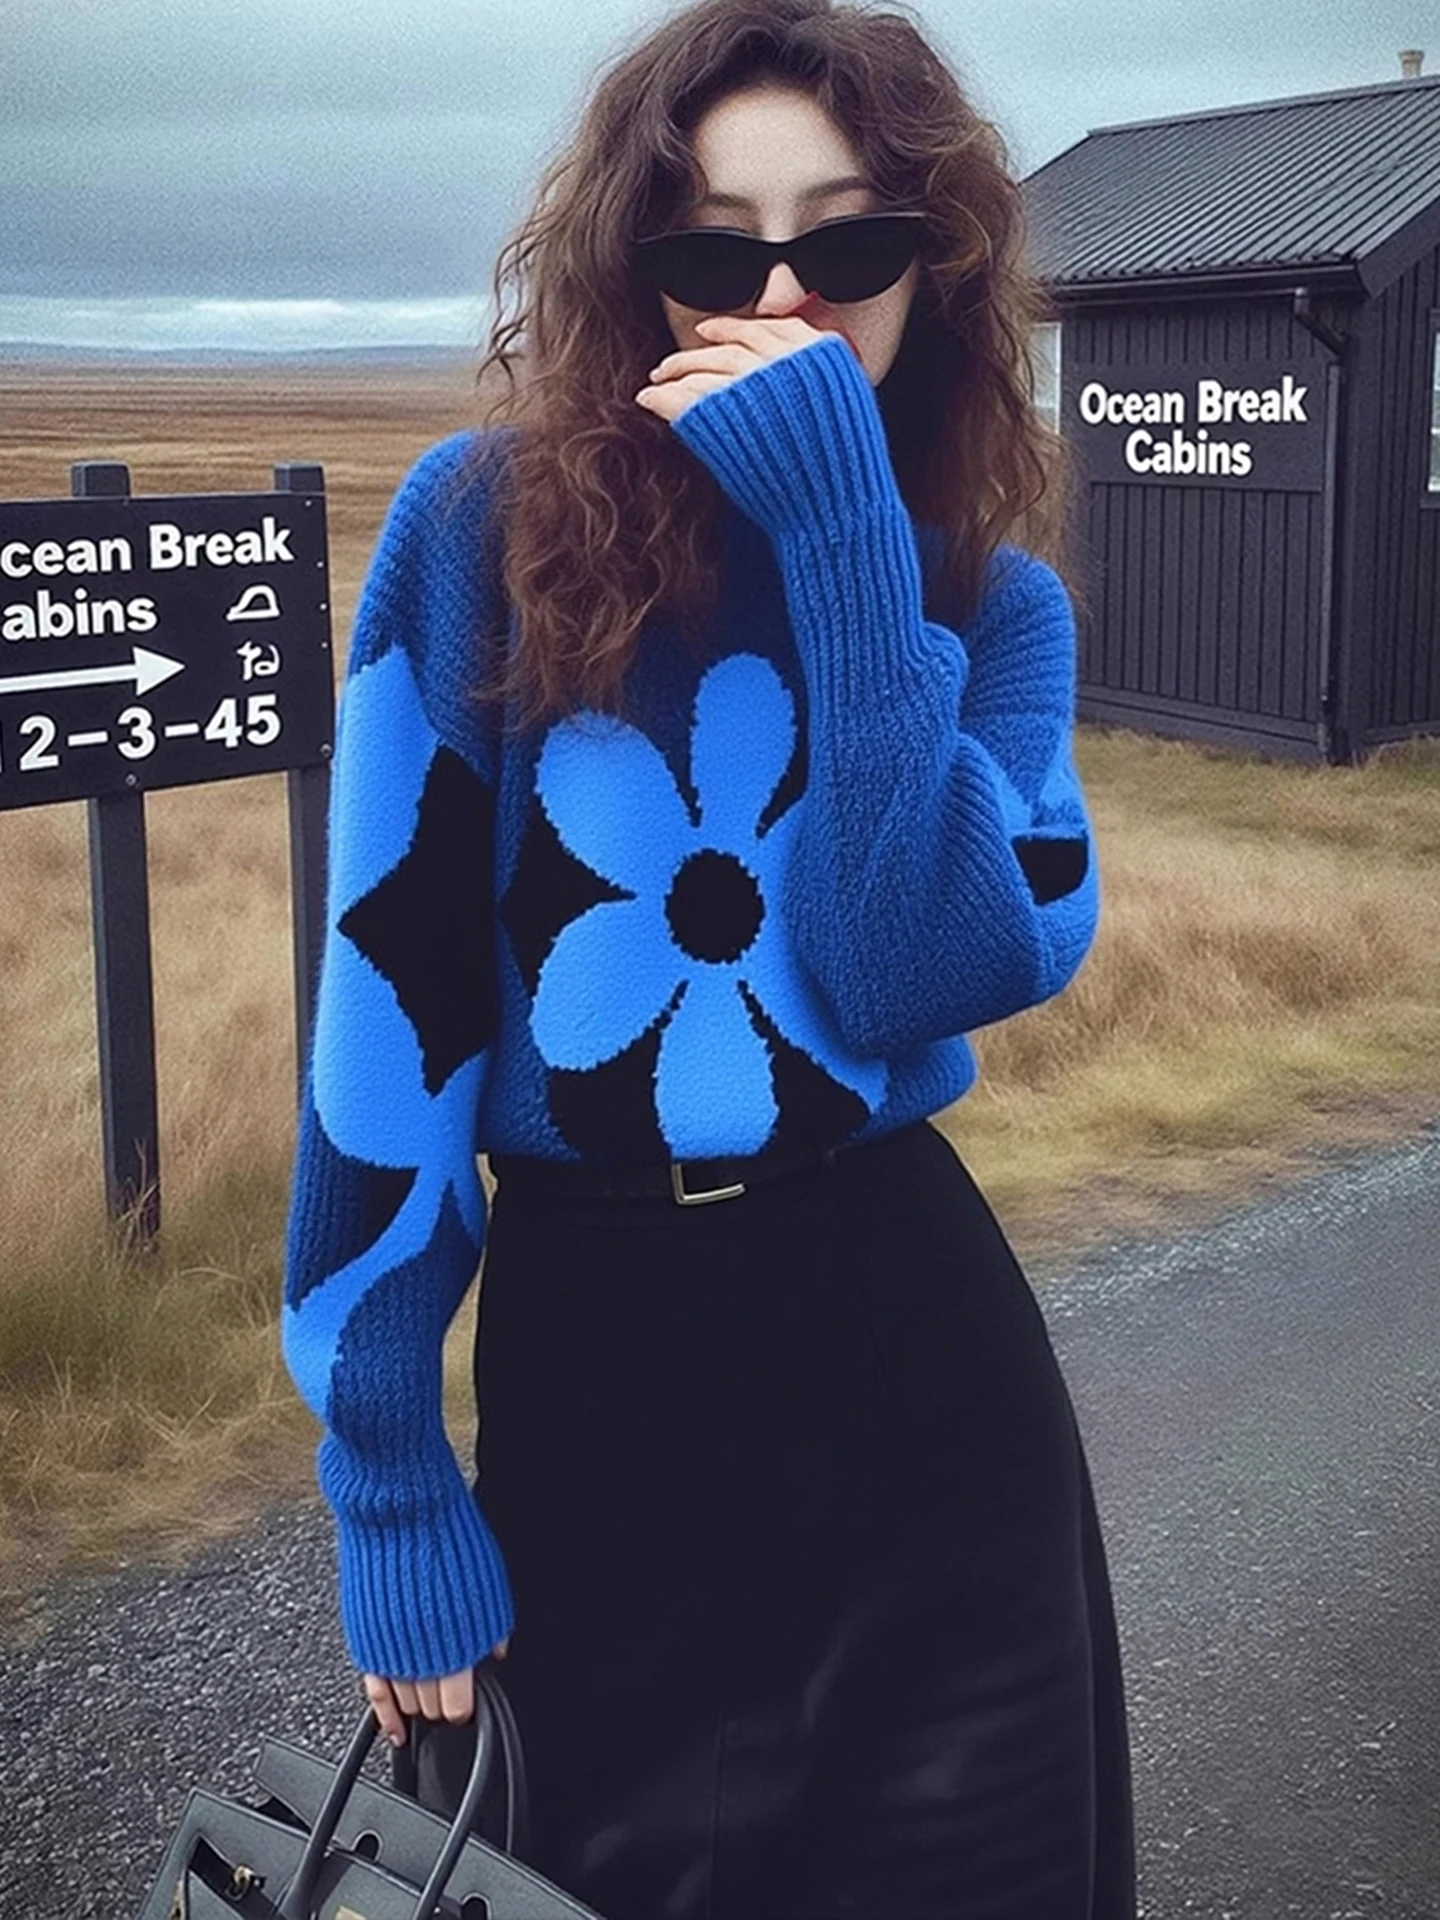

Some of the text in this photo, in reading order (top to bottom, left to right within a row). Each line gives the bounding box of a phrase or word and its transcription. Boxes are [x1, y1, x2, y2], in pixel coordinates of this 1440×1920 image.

[1079, 375, 1308, 424] Ocean Break
[1125, 428, 1253, 476] Cabins
[0, 516, 294, 578] cean Break
[2, 587, 158, 641] abins
